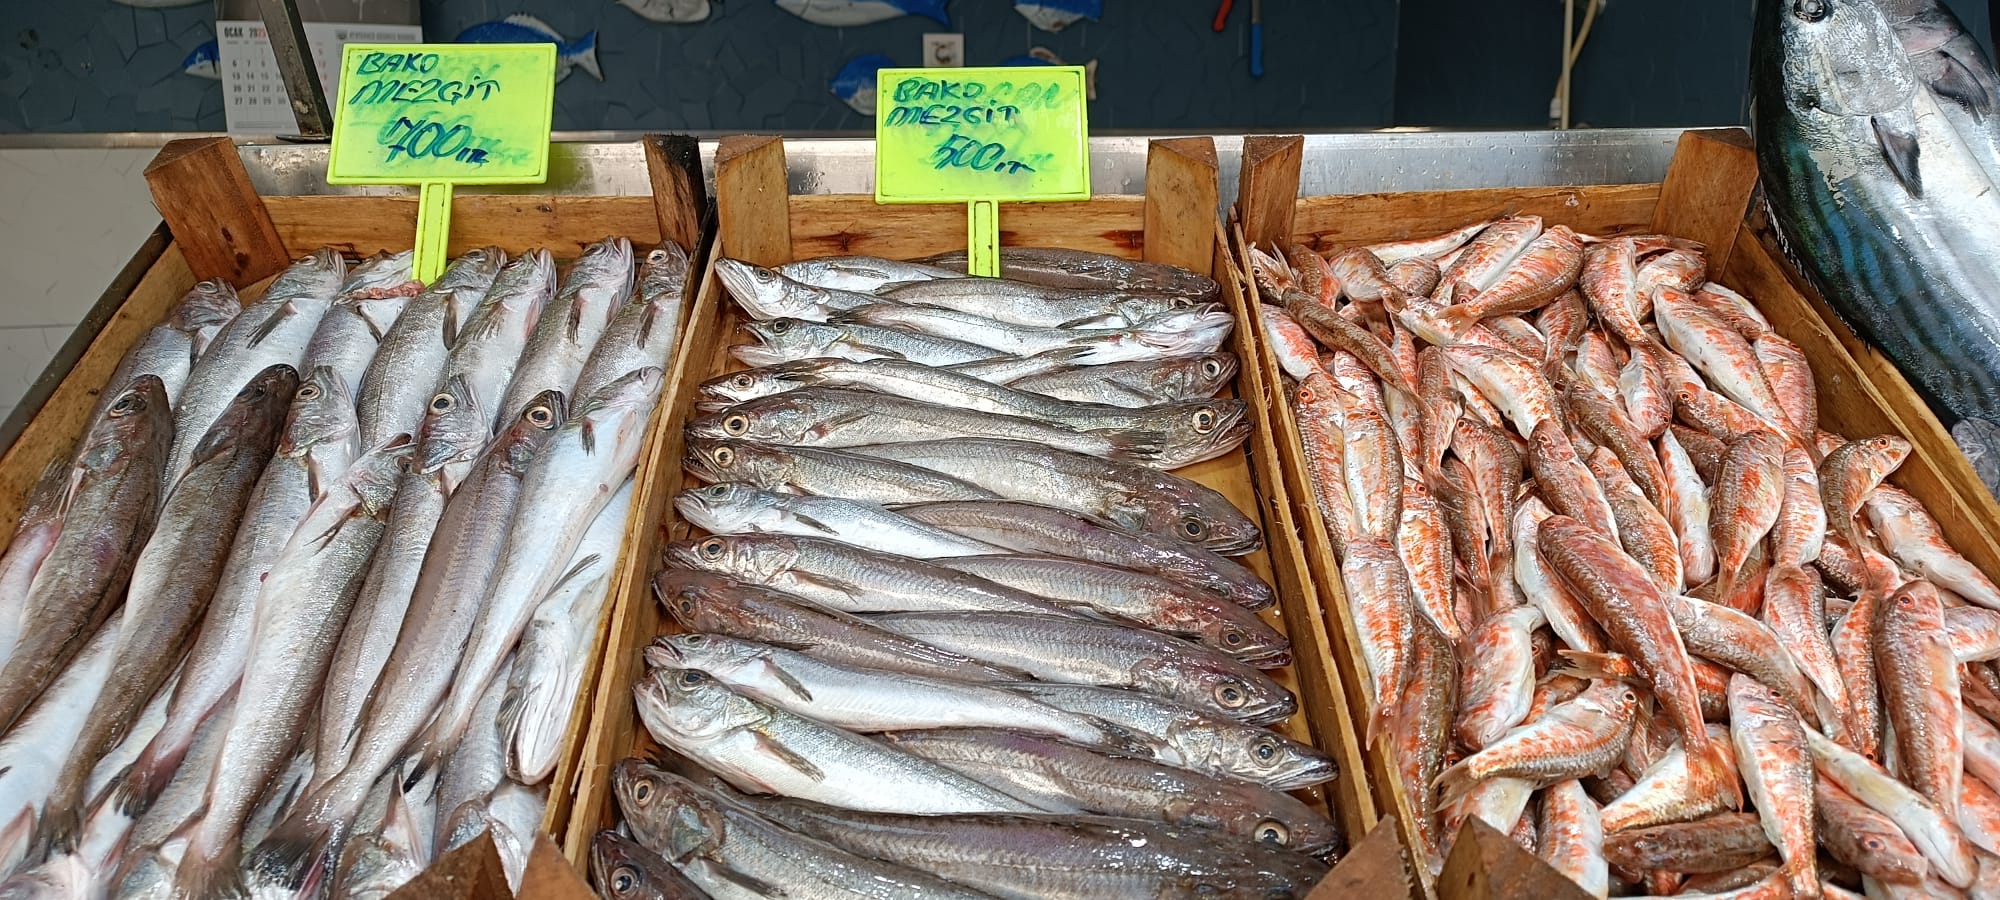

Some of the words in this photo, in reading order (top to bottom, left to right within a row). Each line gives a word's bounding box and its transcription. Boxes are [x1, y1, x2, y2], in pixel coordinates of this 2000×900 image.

[224, 26, 244, 38] OCAK
[357, 53, 439, 75] BAKO
[894, 78, 985, 102] BAKO
